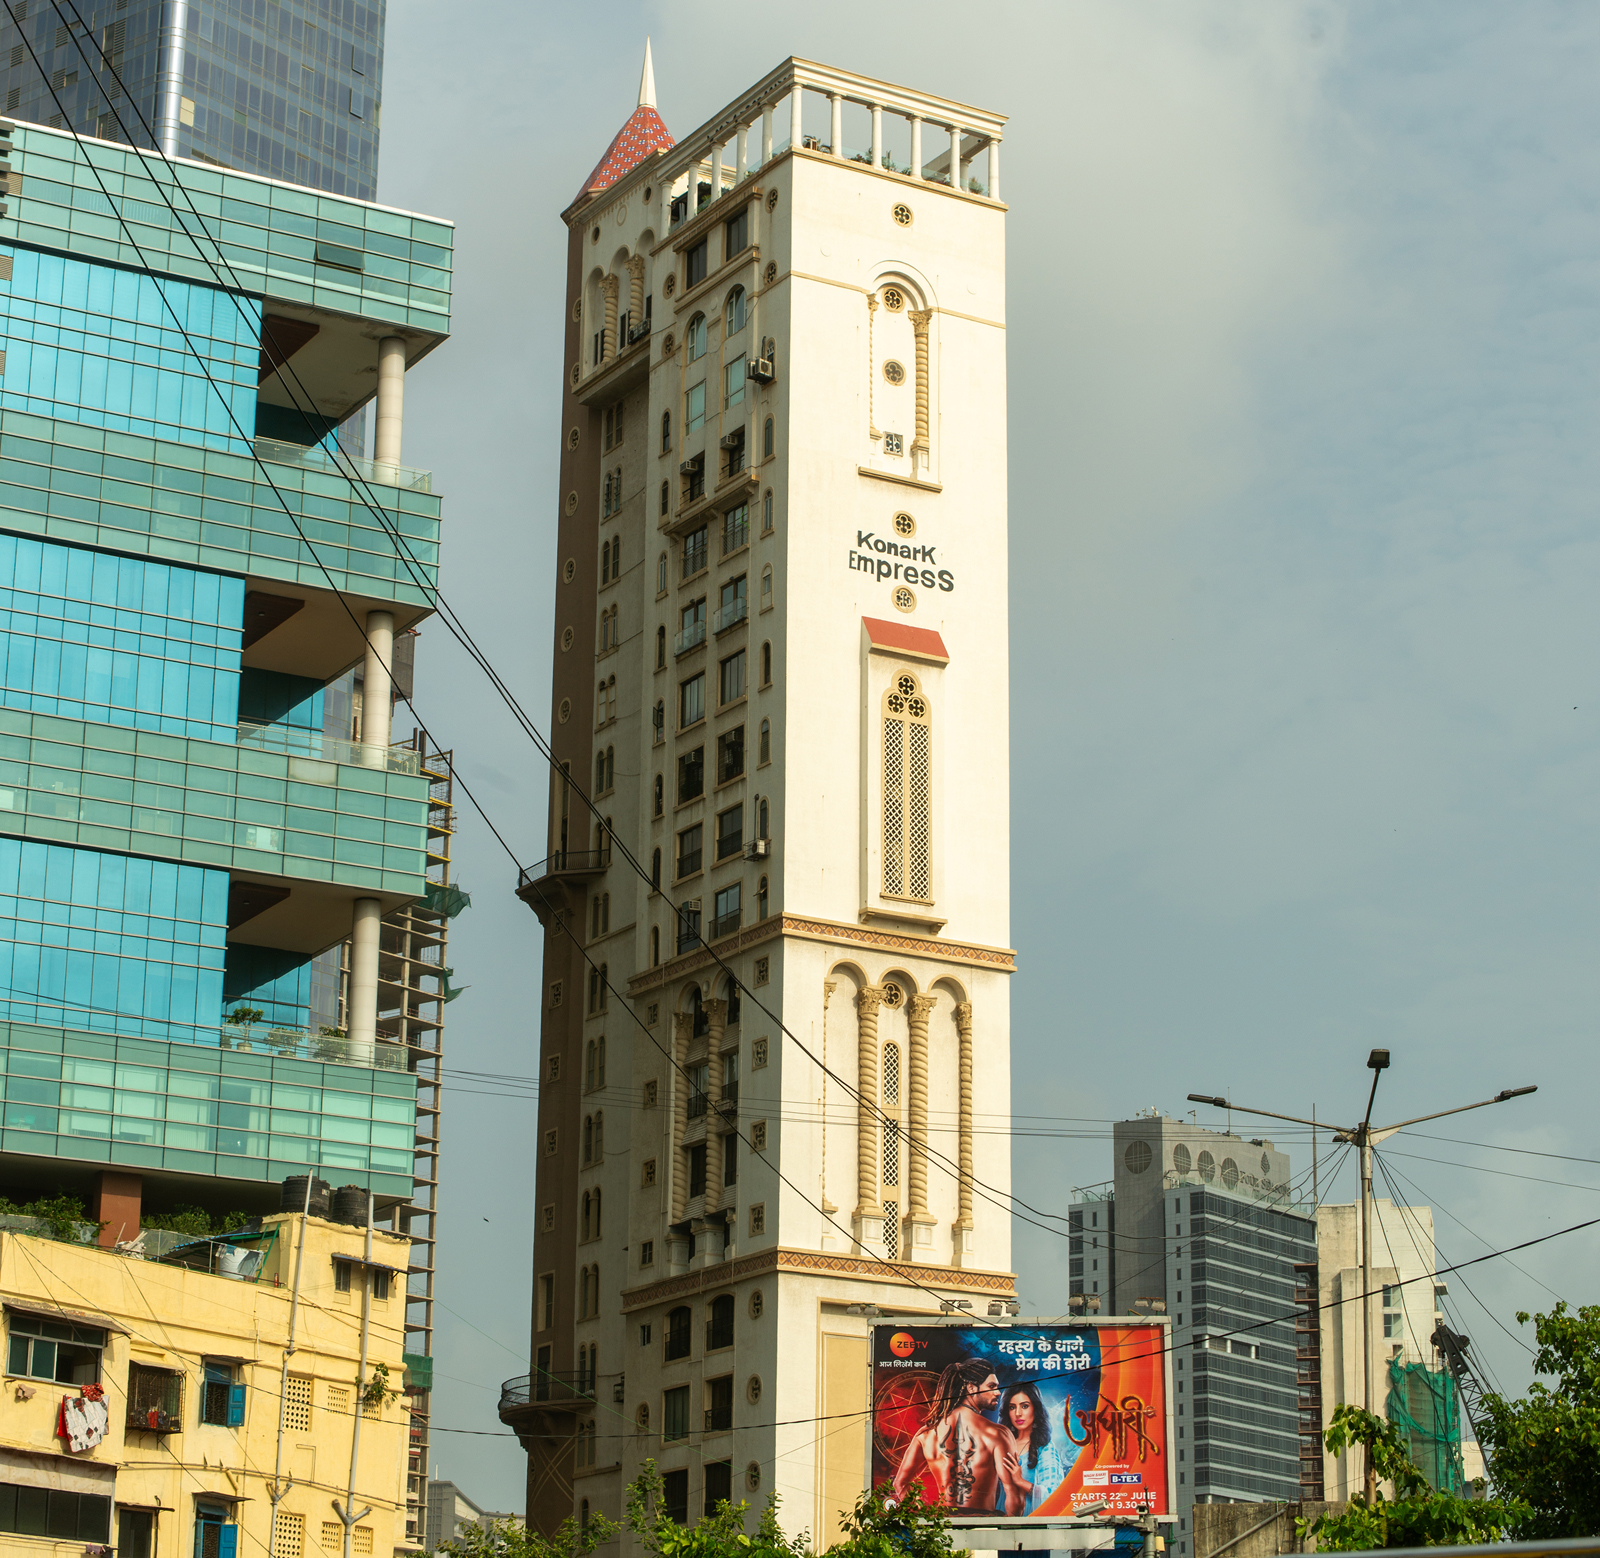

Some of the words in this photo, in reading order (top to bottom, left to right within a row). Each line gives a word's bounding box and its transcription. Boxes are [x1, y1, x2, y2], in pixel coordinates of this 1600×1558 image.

[849, 550, 954, 592] Empress
[997, 1339, 1035, 1354] रहस्य
[1037, 1336, 1052, 1352] के
[1055, 1335, 1085, 1352] धागे
[1015, 1353, 1040, 1370] प्रेम
[1041, 1353, 1062, 1370] की
[1063, 1353, 1091, 1370] डोरी
[1112, 1475, 1138, 1483] B-TEX
[1070, 1492, 1107, 1501] STARTS
[1131, 1492, 1156, 1500] JUNE
[1116, 1501, 1137, 1509] 9.30
